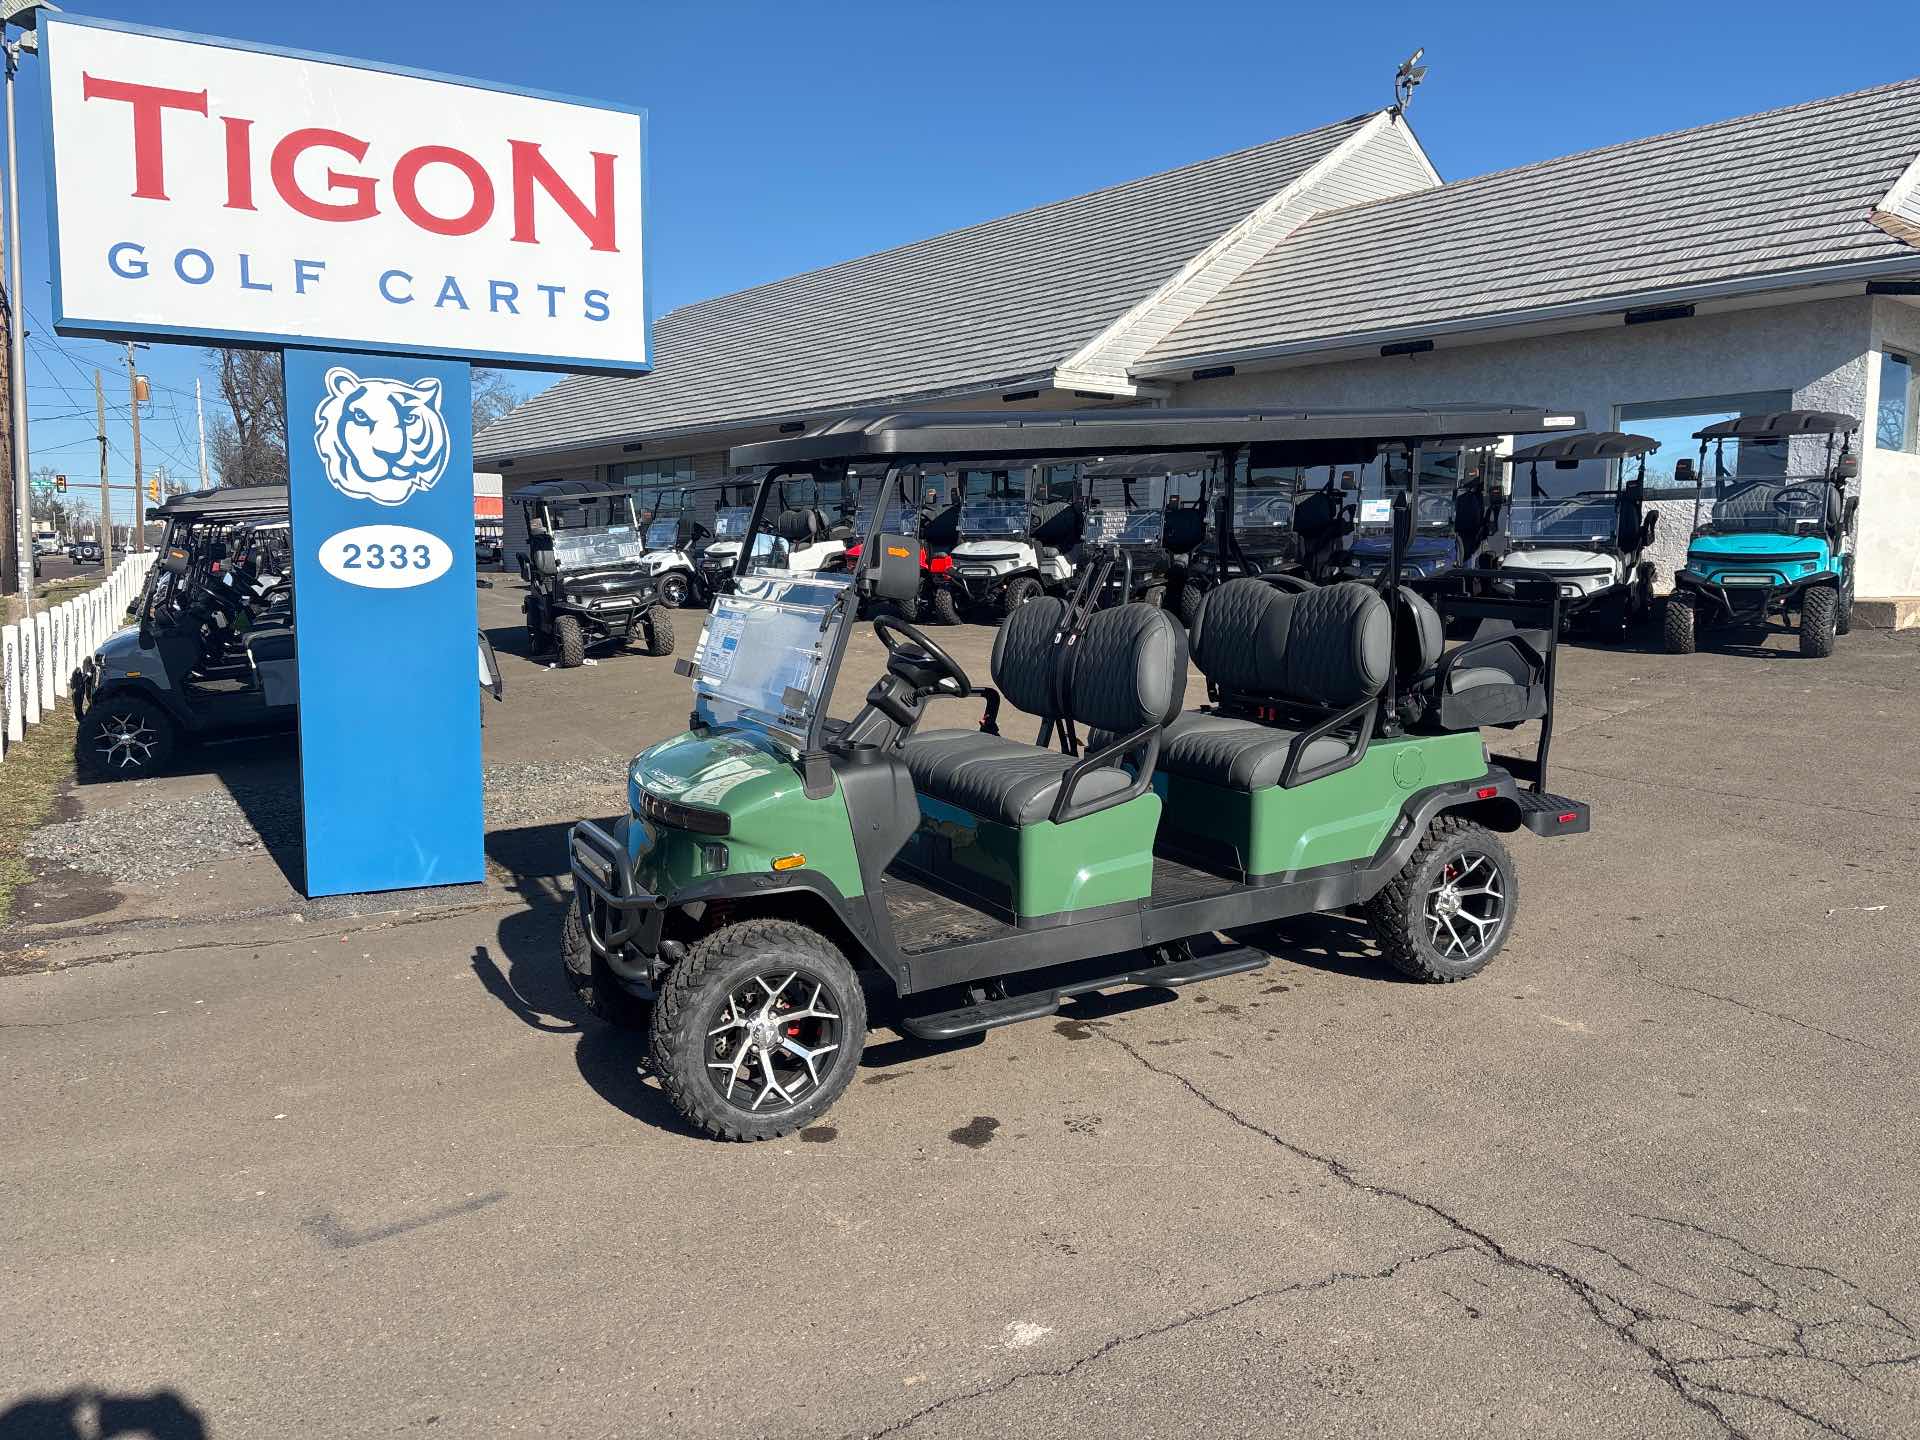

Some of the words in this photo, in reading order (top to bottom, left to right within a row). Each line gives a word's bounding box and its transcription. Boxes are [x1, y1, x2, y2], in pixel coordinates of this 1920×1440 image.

[82, 70, 620, 253] TIGON
[107, 241, 326, 294] GOLF
[378, 269, 610, 322] CARTS
[342, 543, 431, 570] 2333
